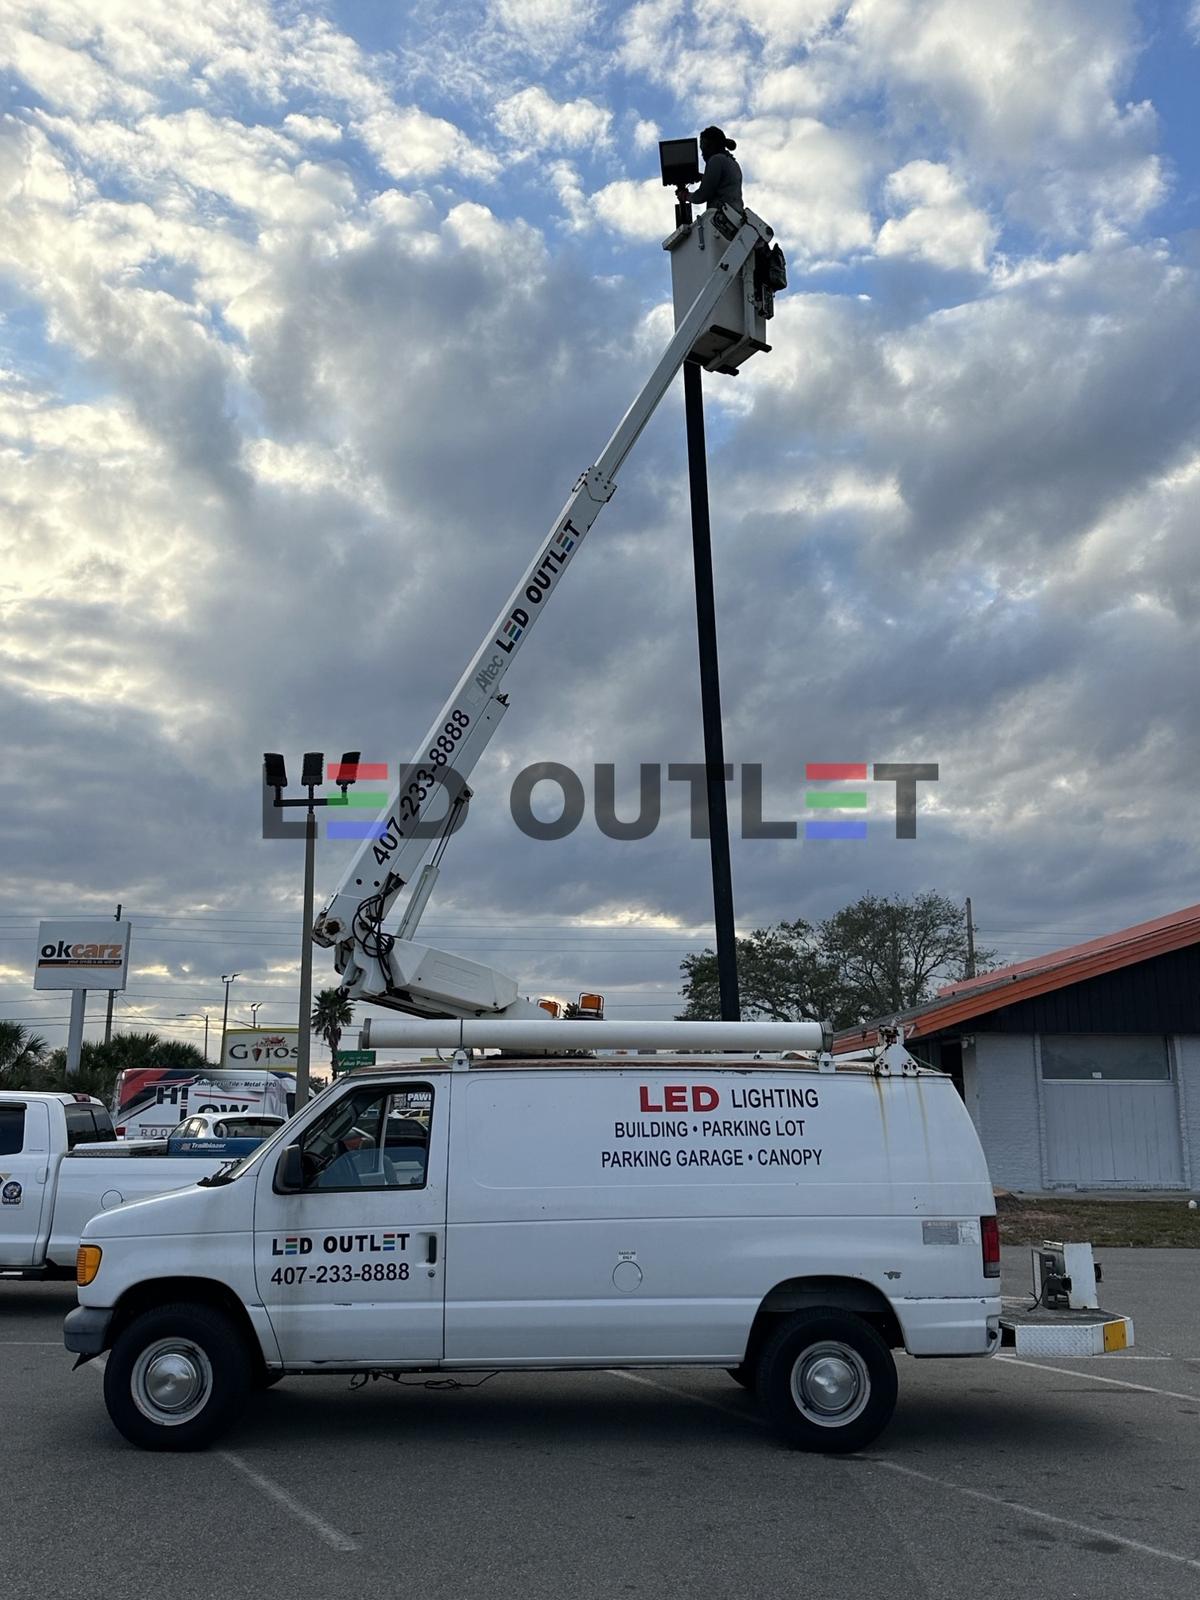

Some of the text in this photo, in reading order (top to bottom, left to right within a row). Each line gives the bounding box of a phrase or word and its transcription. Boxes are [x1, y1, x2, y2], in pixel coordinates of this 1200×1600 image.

[496, 519, 580, 654] LED OUTLET
[475, 655, 504, 694] Altec
[372, 709, 470, 866] 407-233-8888
[41, 940, 123, 959] okcarz
[244, 1080, 261, 1088] Metal
[639, 1086, 819, 1113] LED LIGHTING
[615, 1120, 805, 1138] BUILDING PARKING LOT
[601, 1149, 823, 1168] PARKING GARAGE CANOPY
[271, 1233, 410, 1256] LED OUTLET
[270, 1262, 410, 1285] 407-233-8888
